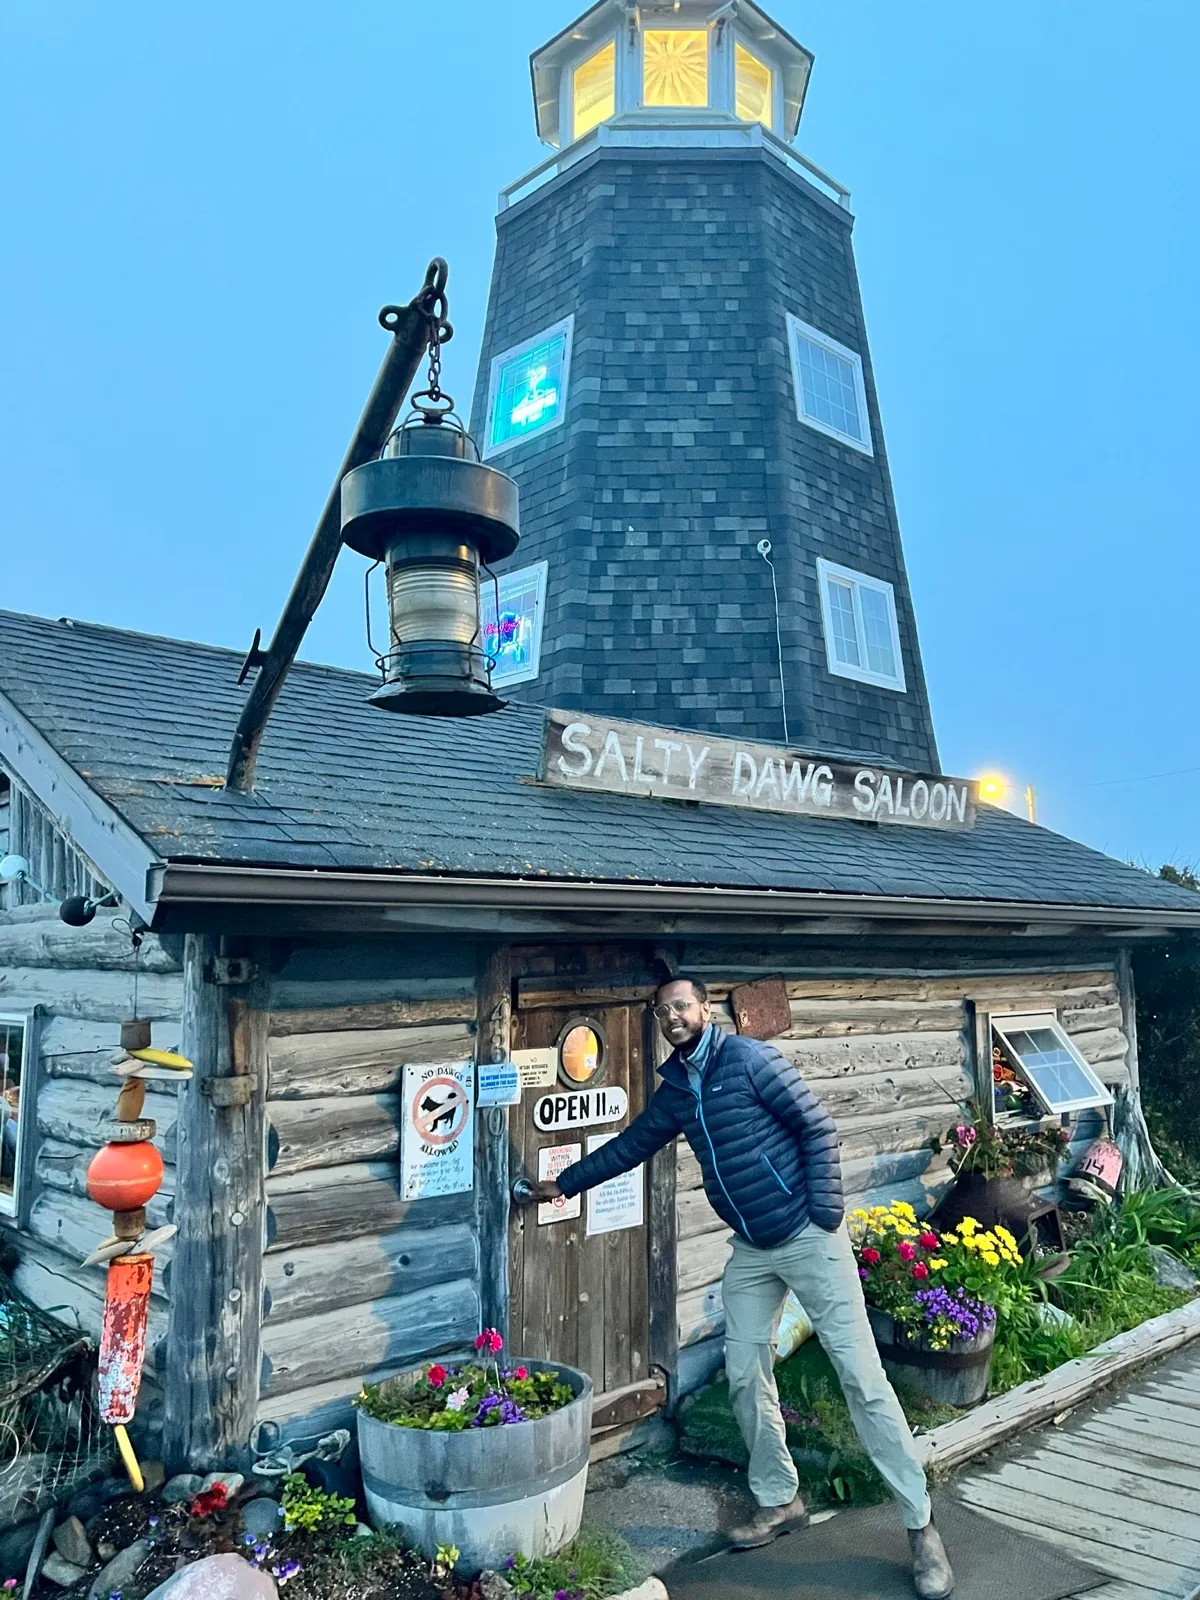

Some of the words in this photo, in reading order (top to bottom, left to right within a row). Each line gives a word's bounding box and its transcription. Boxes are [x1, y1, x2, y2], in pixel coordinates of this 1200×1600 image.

[557, 722, 708, 789] SALTY
[731, 751, 834, 808] DAWG
[852, 769, 968, 823] SALOON
[421, 1069, 434, 1082] NO
[437, 1067, 464, 1082] DAWGS
[539, 1094, 590, 1125] OPEN
[596, 1092, 606, 1117] 11
[608, 1104, 620, 1115] AM
[420, 1139, 459, 1157] ALLOWED
[548, 1146, 573, 1156] SMOKING
[551, 1154, 570, 1162] WITHIN
